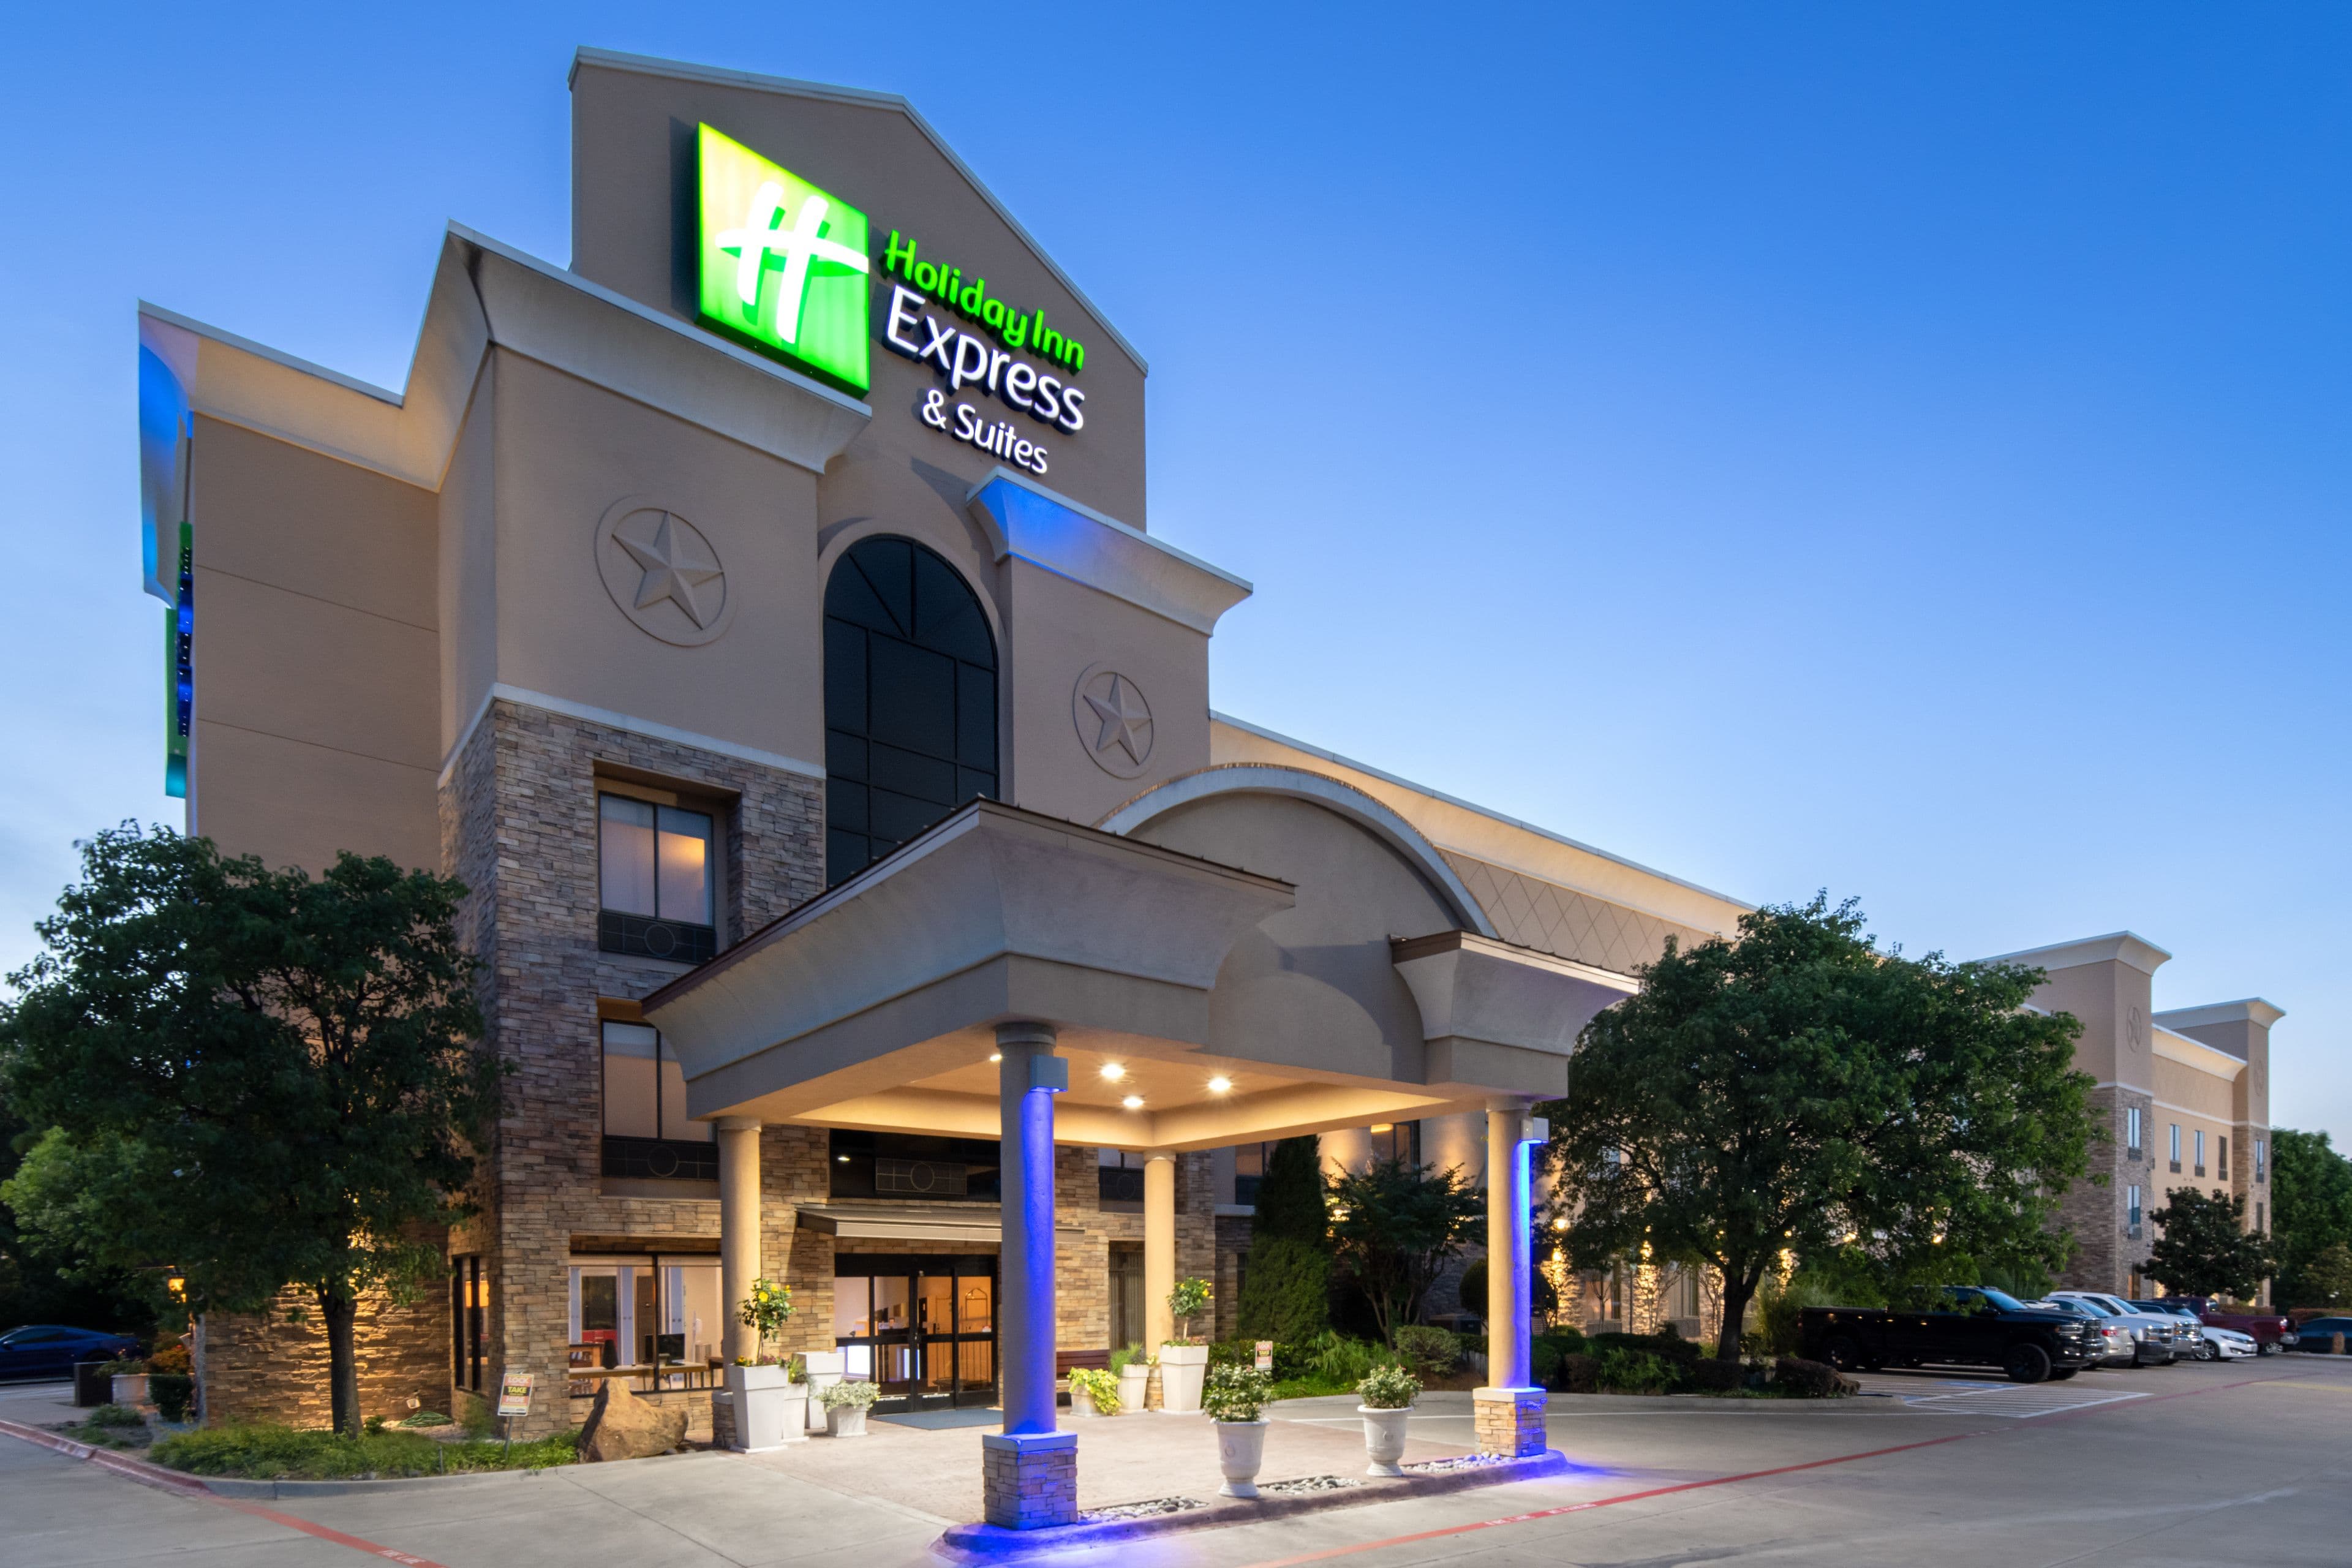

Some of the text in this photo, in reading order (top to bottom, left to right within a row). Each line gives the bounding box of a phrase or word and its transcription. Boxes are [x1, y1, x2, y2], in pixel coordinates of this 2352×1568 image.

[884, 229, 1085, 371] Holiday Inn
[887, 284, 1085, 431] Express
[922, 390, 1048, 475] & Suites
